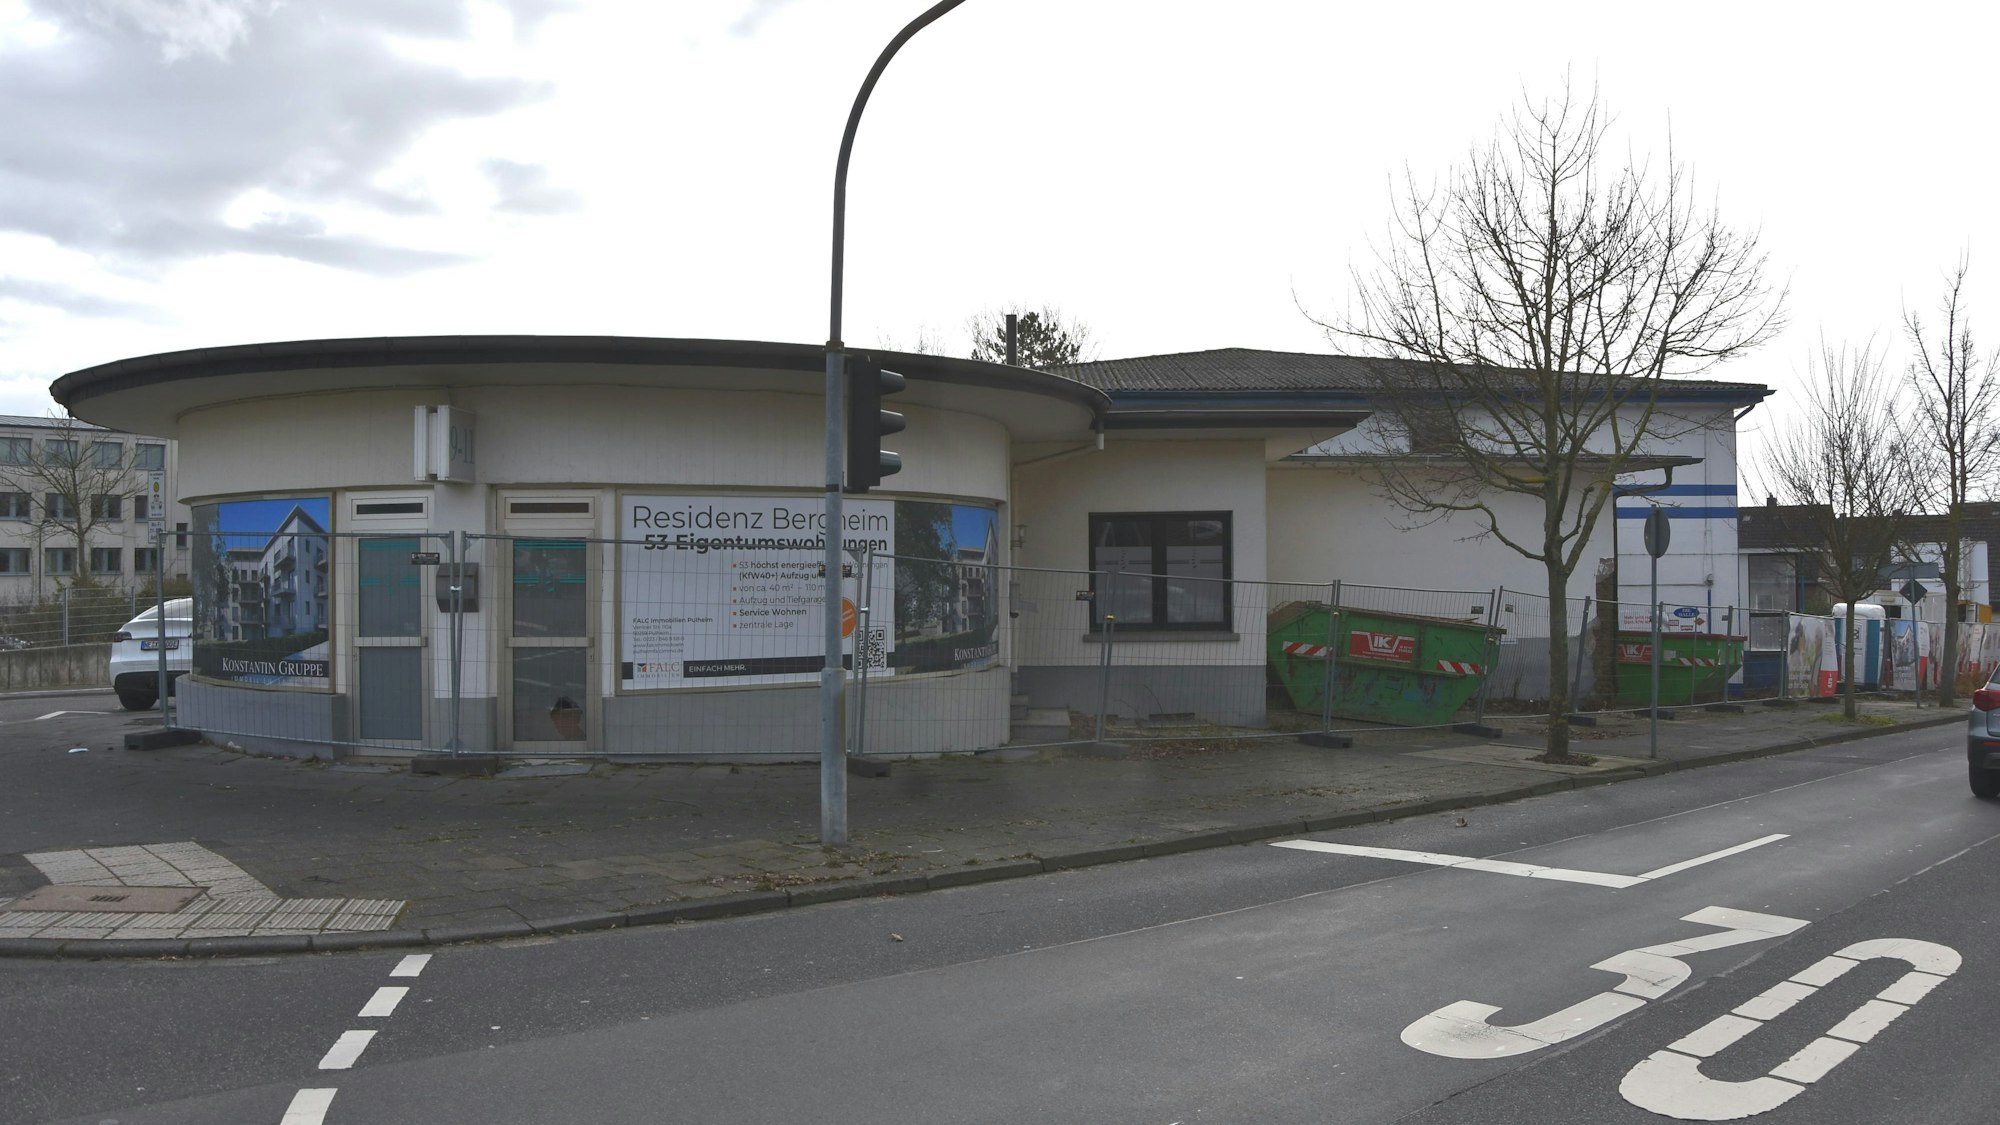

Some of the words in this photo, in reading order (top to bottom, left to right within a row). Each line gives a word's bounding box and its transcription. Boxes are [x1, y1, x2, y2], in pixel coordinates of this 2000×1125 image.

[633, 505, 763, 529] Residenz
[644, 534, 669, 550] 53
[750, 561, 780, 569] höchst
[739, 572, 778, 581] (KfW40+)
[780, 572, 813, 580] Aufzug
[739, 597, 768, 605] Aufzug
[769, 596, 786, 604] und
[739, 608, 769, 616] Service
[772, 608, 807, 616] Wohnen
[739, 621, 772, 629] zentrale
[774, 620, 794, 630] Lage
[222, 657, 276, 675] KONSTANTIN
[278, 660, 324, 677] GRUPPE
[649, 662, 680, 672] FALC
[689, 665, 722, 673] EINFACH
[723, 664, 747, 672] MEHR.
[1400, 905, 1963, 1121] 30
